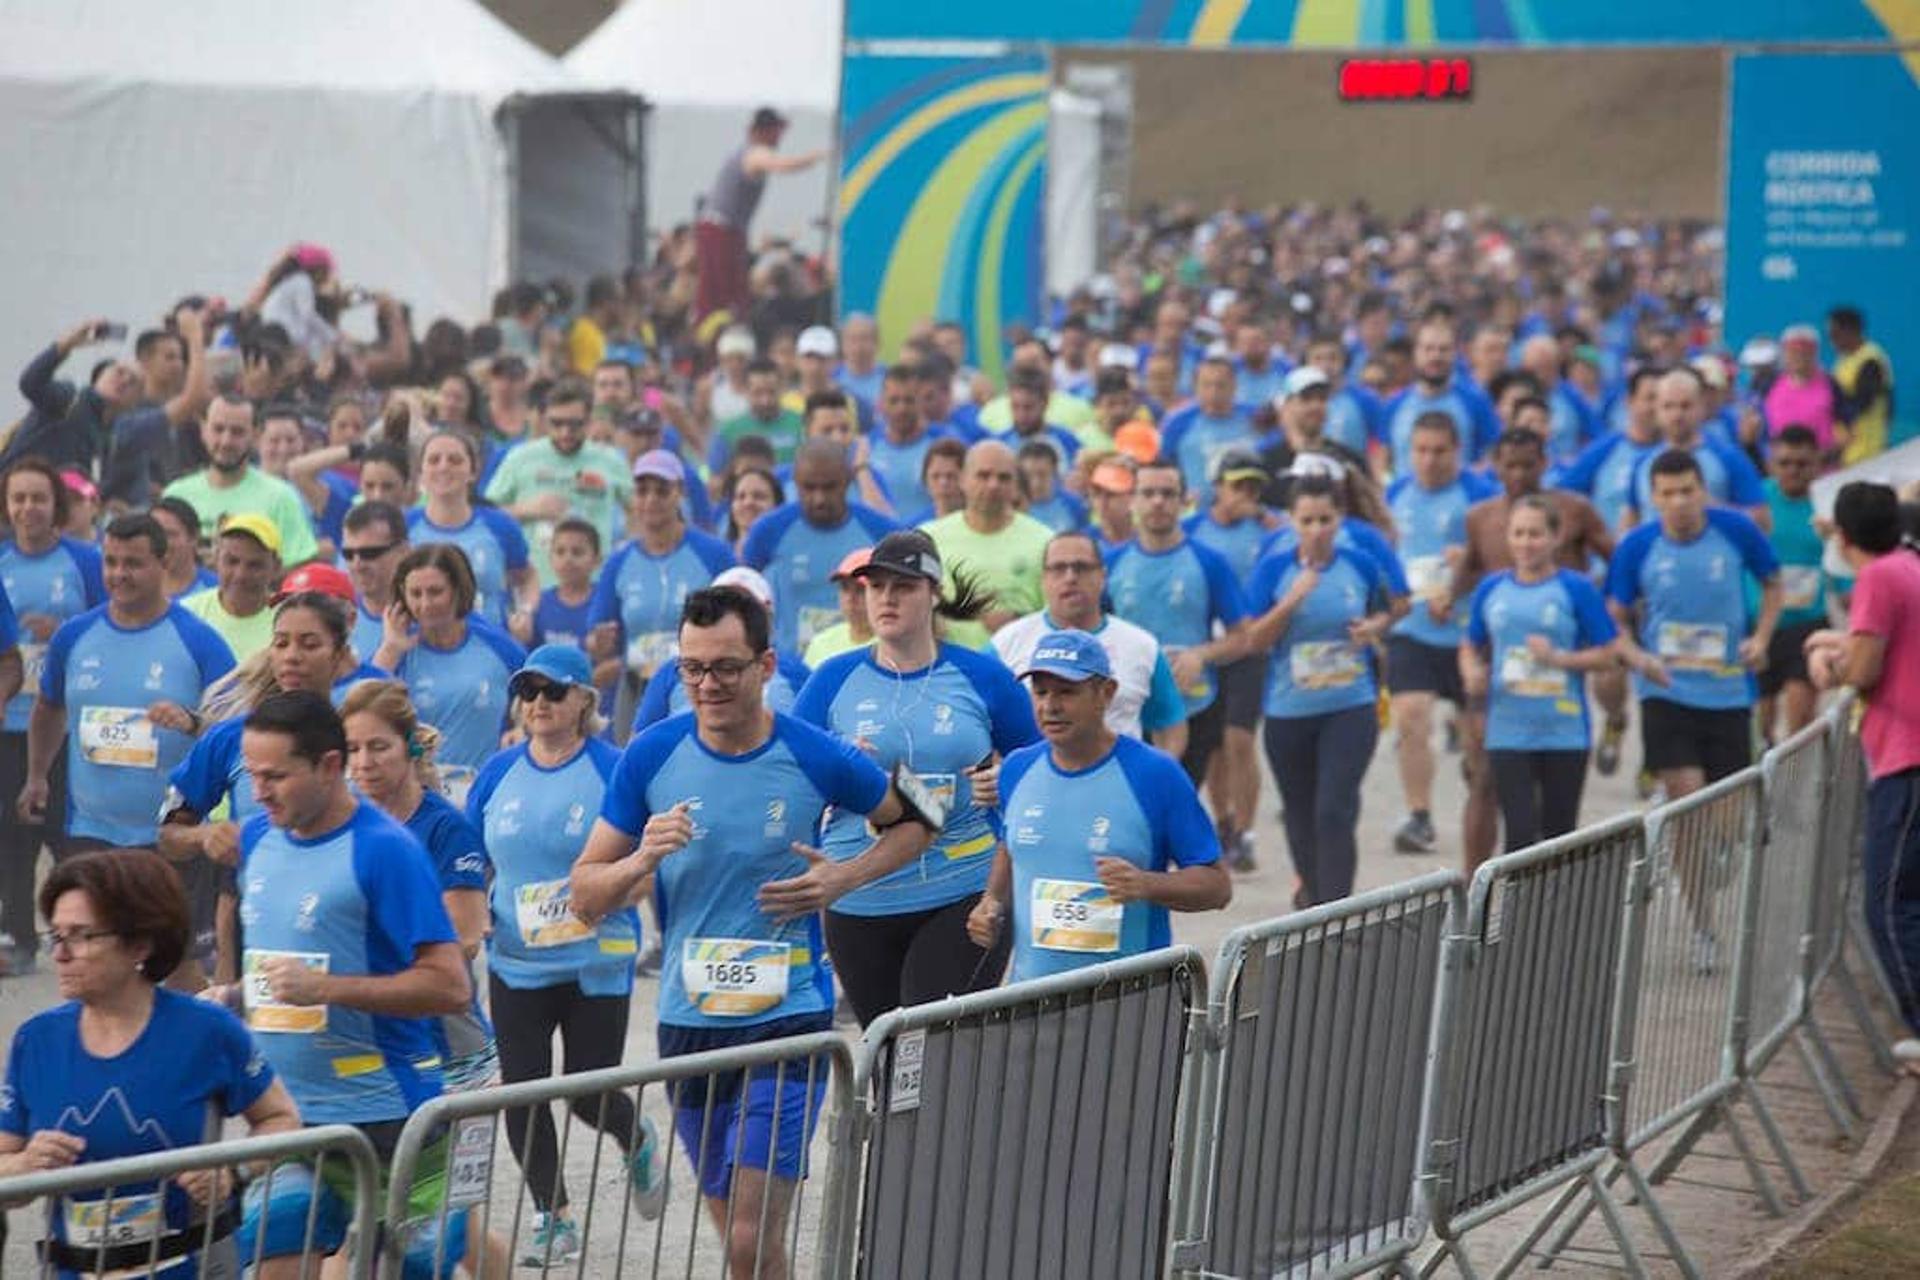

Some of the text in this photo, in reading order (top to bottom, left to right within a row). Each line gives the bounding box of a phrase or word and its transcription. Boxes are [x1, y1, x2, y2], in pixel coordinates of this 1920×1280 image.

[100, 725, 130, 742] 825
[1053, 902, 1087, 921] 658
[705, 963, 757, 984] 1685
